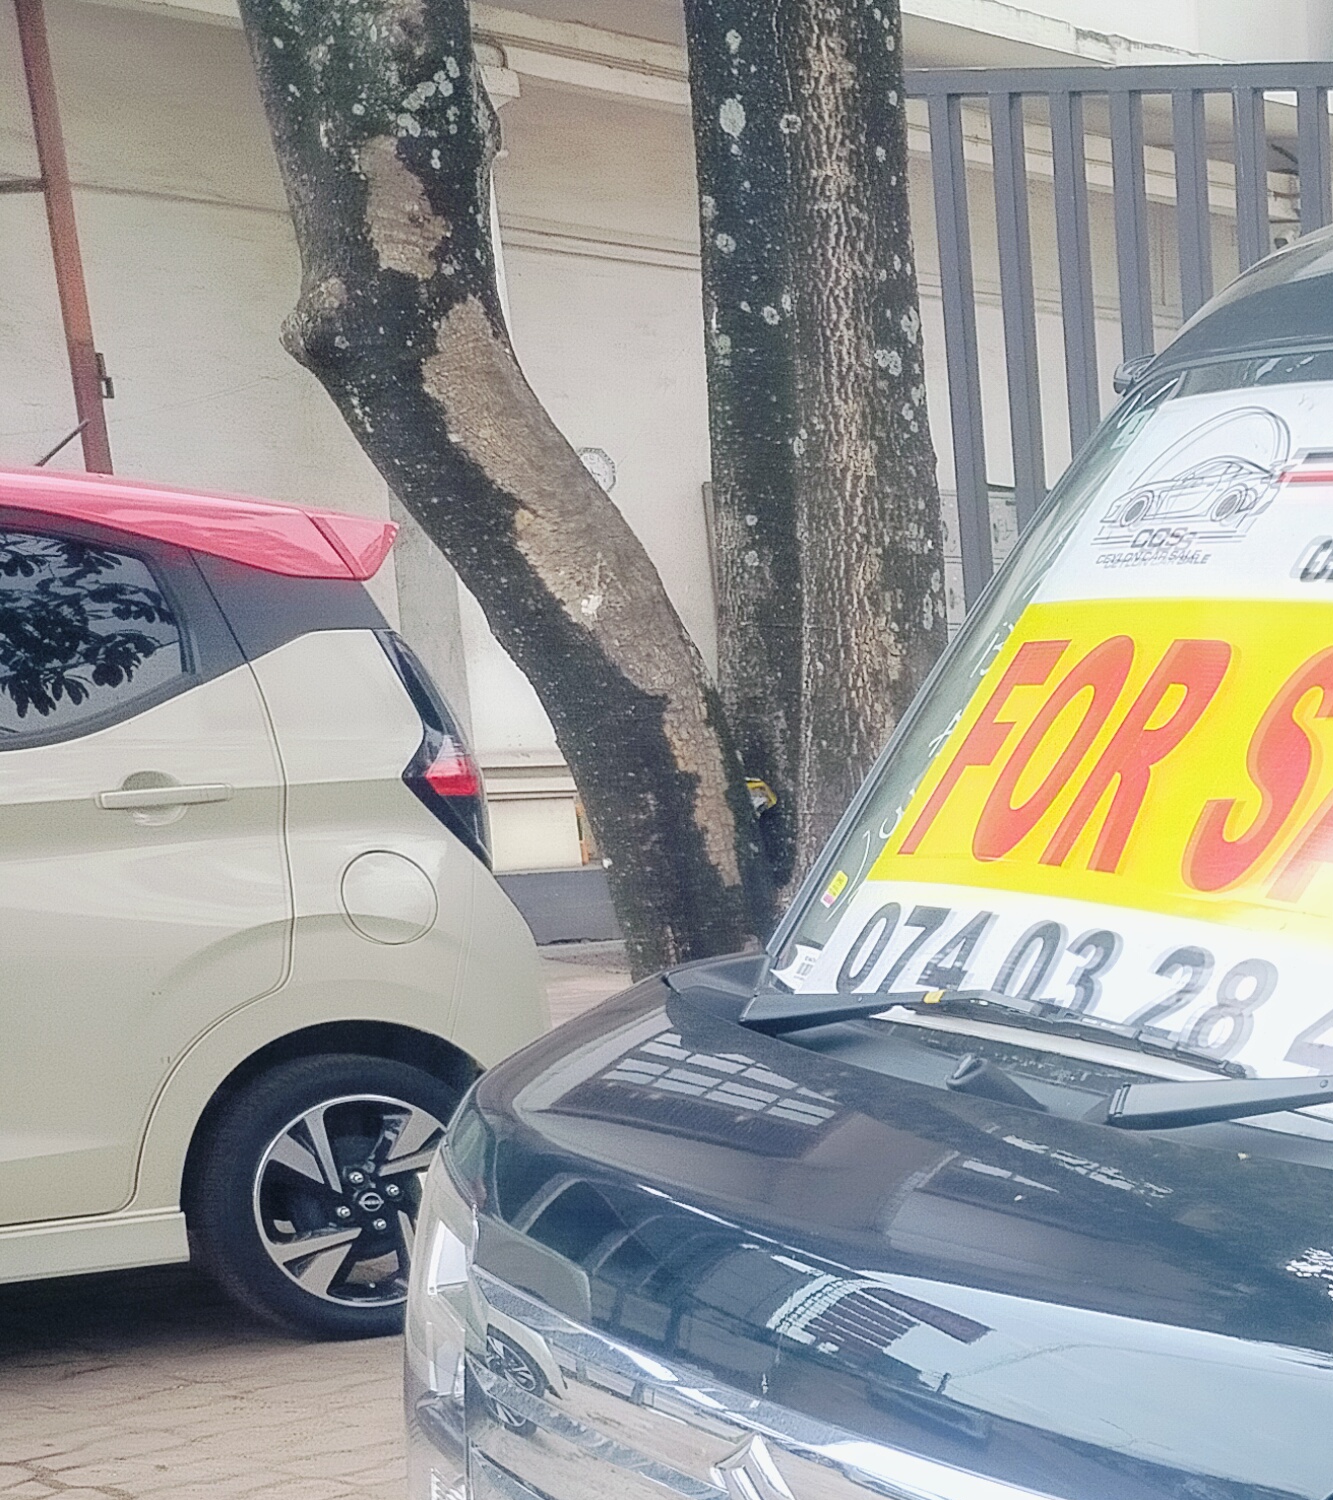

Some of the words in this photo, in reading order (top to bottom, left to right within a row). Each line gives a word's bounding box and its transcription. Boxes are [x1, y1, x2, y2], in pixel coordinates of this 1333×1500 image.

[898, 634, 1232, 873] FOR
[836, 902, 1001, 995] 074
[991, 919, 1124, 1016] 03
[1123, 945, 1280, 1060] 28
